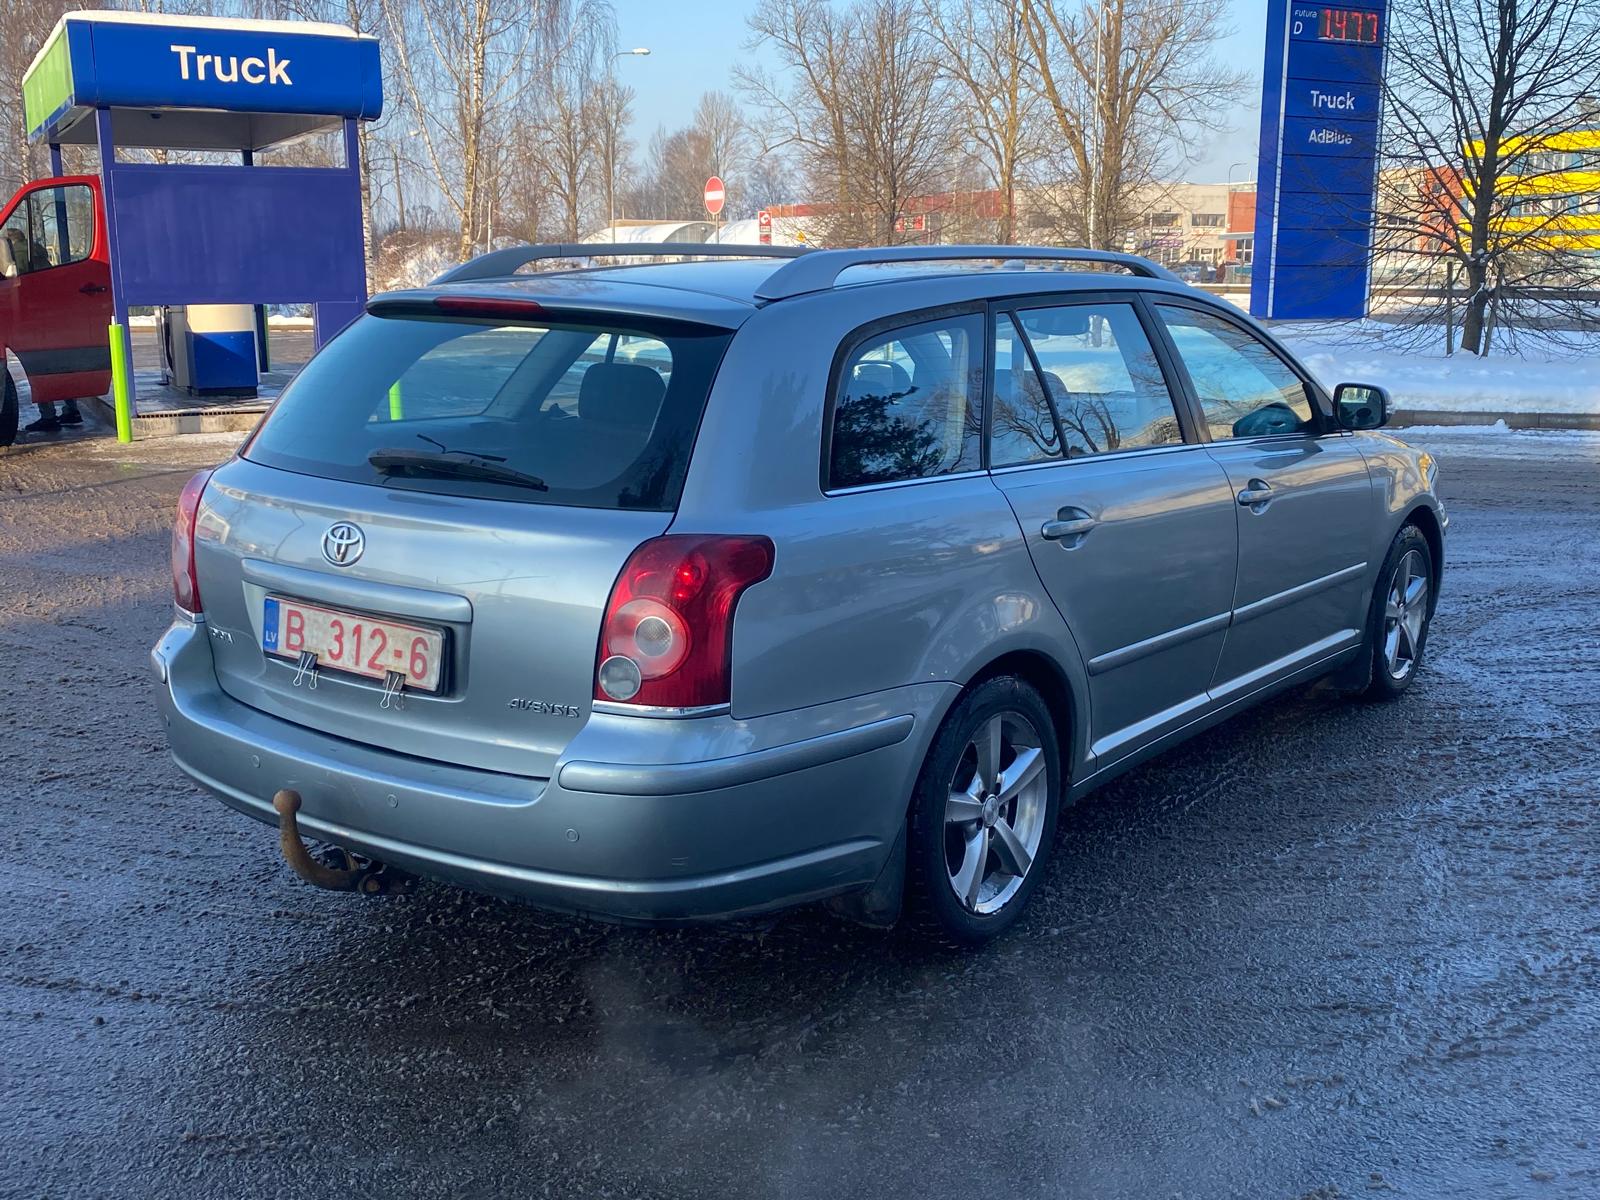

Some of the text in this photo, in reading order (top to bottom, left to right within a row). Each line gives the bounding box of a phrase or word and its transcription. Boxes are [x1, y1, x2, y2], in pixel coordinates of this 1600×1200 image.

[1293, 21, 1303, 35] D
[170, 45, 293, 86] Truck
[1310, 90, 1356, 110] Truck
[1308, 128, 1353, 145] AdBlue
[265, 632, 277, 643] LV
[285, 609, 429, 681] B 312-6
